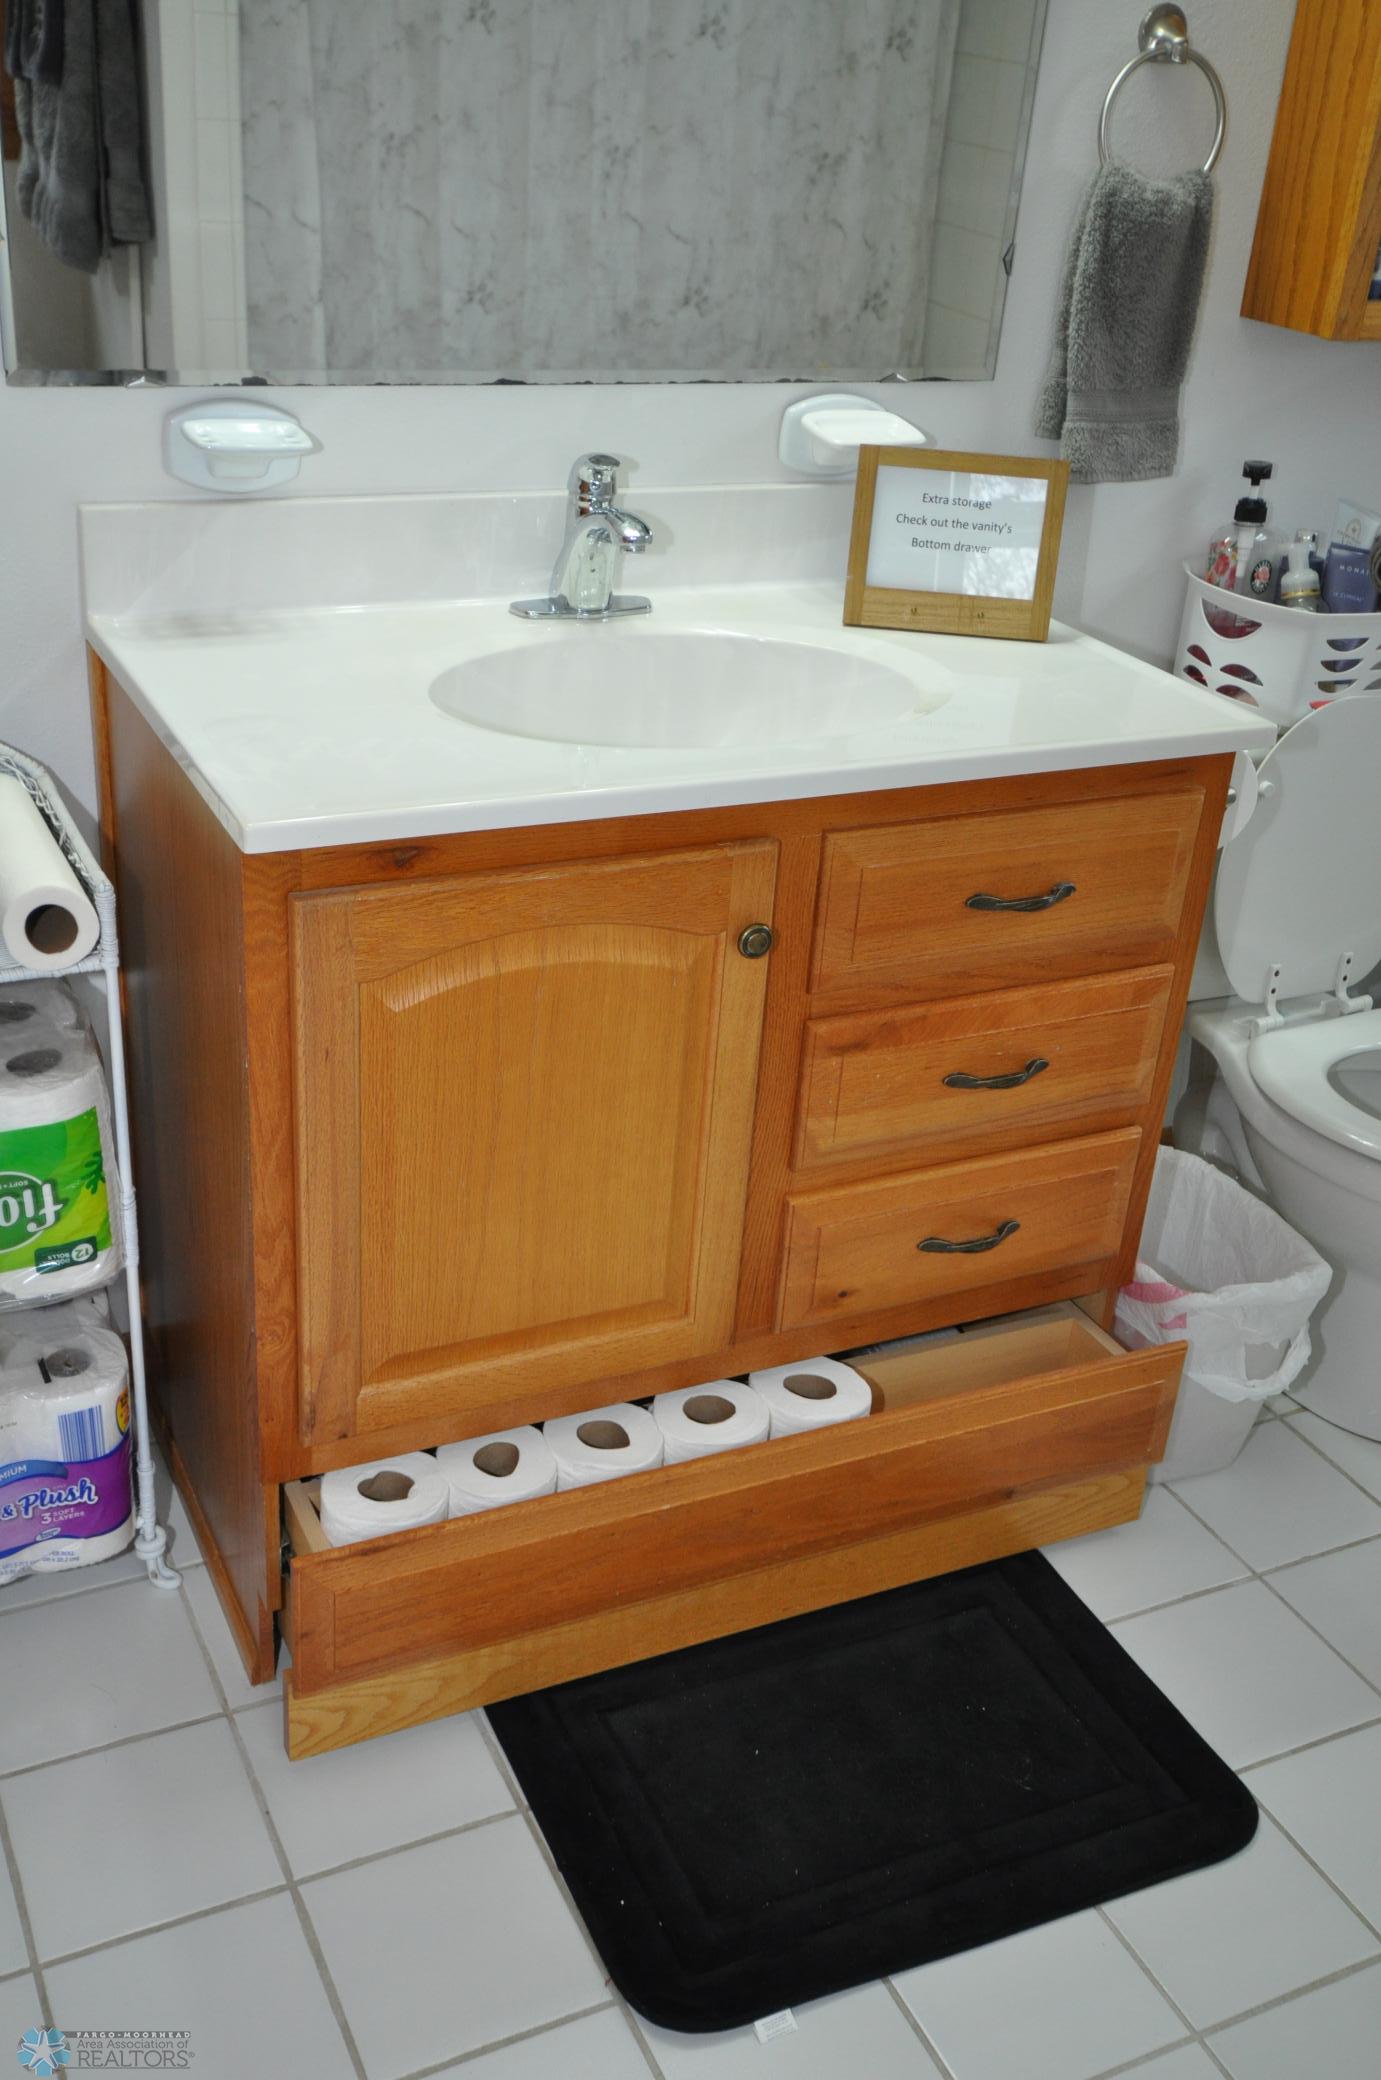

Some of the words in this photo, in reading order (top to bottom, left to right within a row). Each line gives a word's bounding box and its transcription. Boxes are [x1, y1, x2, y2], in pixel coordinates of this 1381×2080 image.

[922, 492, 949, 505] Extra
[952, 496, 992, 510] storage
[896, 513, 927, 526] Check
[930, 518, 949, 529] out
[950, 518, 969, 530] the
[972, 522, 1013, 535] vanity's
[911, 537, 951, 551] Bottom
[953, 540, 992, 554] drawer
[74, 1247, 90, 1259] 12
[1, 1503, 15, 1518] &
[18, 1479, 97, 1517] Plush
[41, 1512, 52, 1525] 3
[52, 1507, 75, 1517] SOFT
